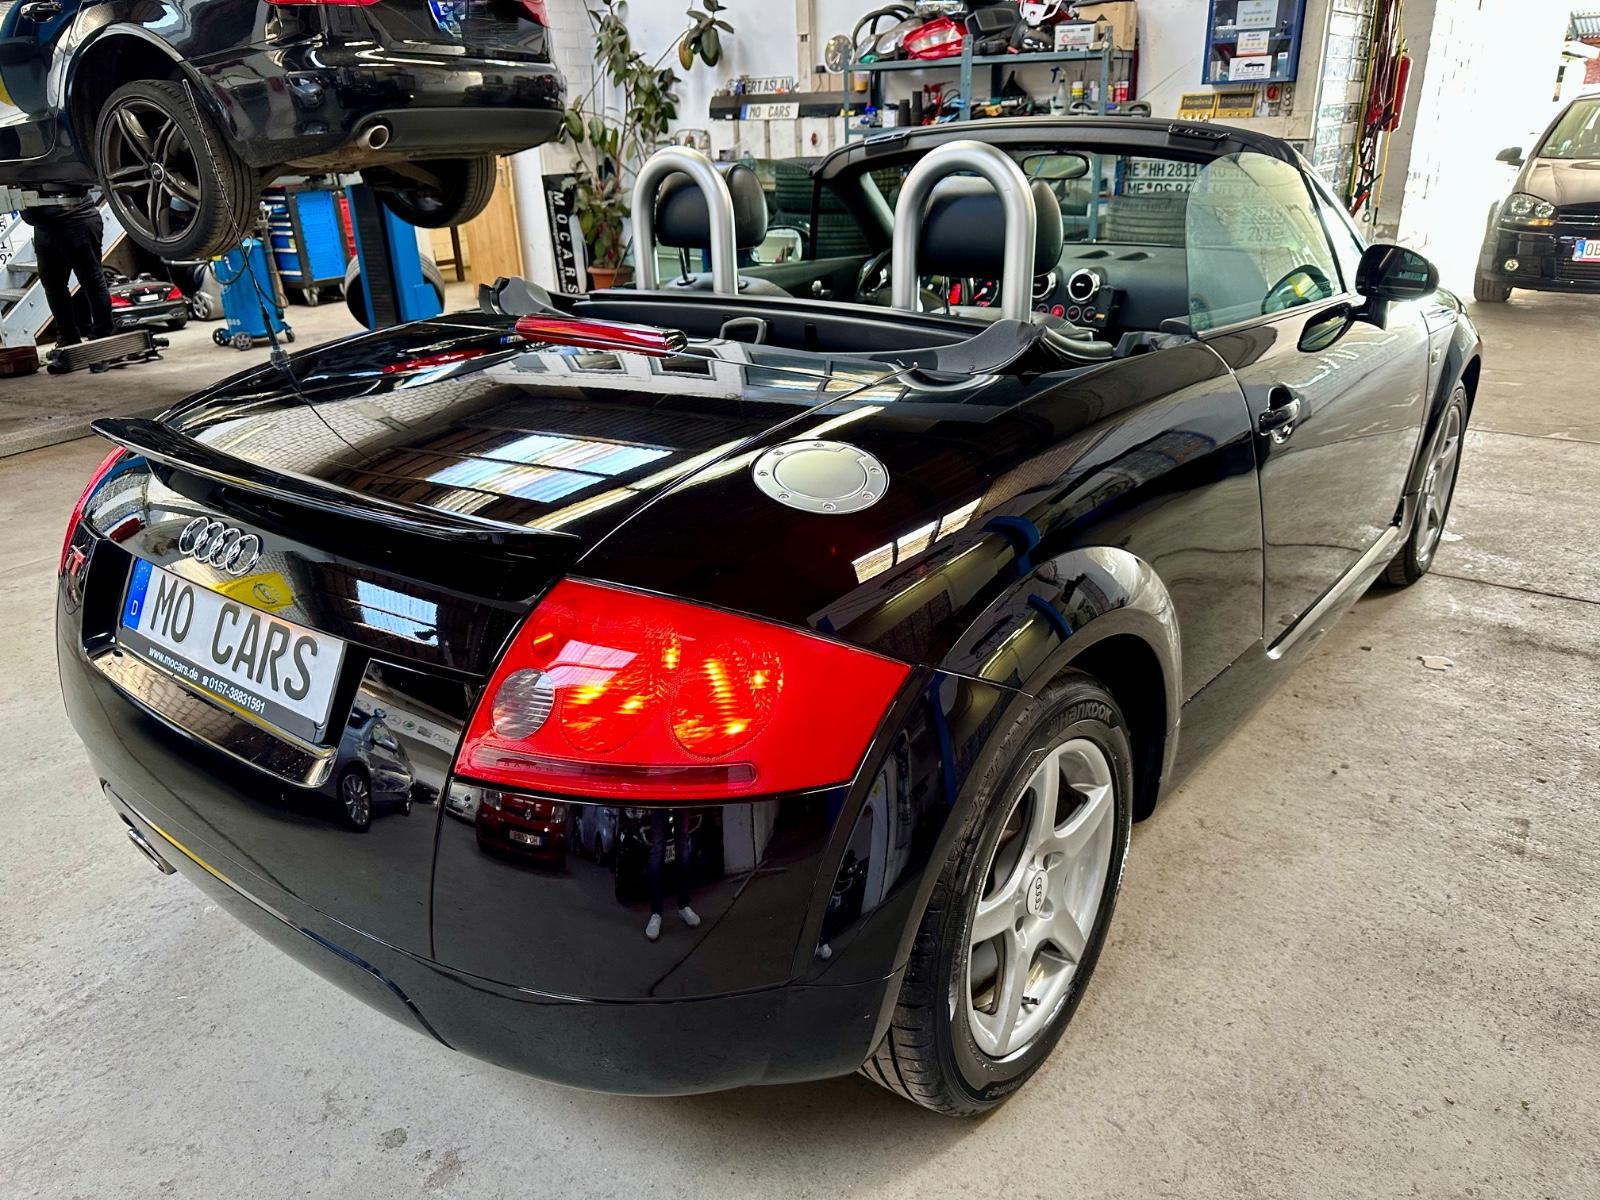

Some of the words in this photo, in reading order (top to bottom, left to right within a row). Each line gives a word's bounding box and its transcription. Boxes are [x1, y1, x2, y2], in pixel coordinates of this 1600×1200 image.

[749, 107, 761, 118] MO
[768, 105, 791, 118] CARS
[1149, 163, 1166, 177] HH
[1167, 163, 1199, 178] 2811
[130, 600, 139, 616] D
[150, 574, 195, 643] MO
[211, 601, 318, 701] CARS
[148, 647, 199, 681] www.mocars.de
[209, 677, 265, 714] 0157-38831591
